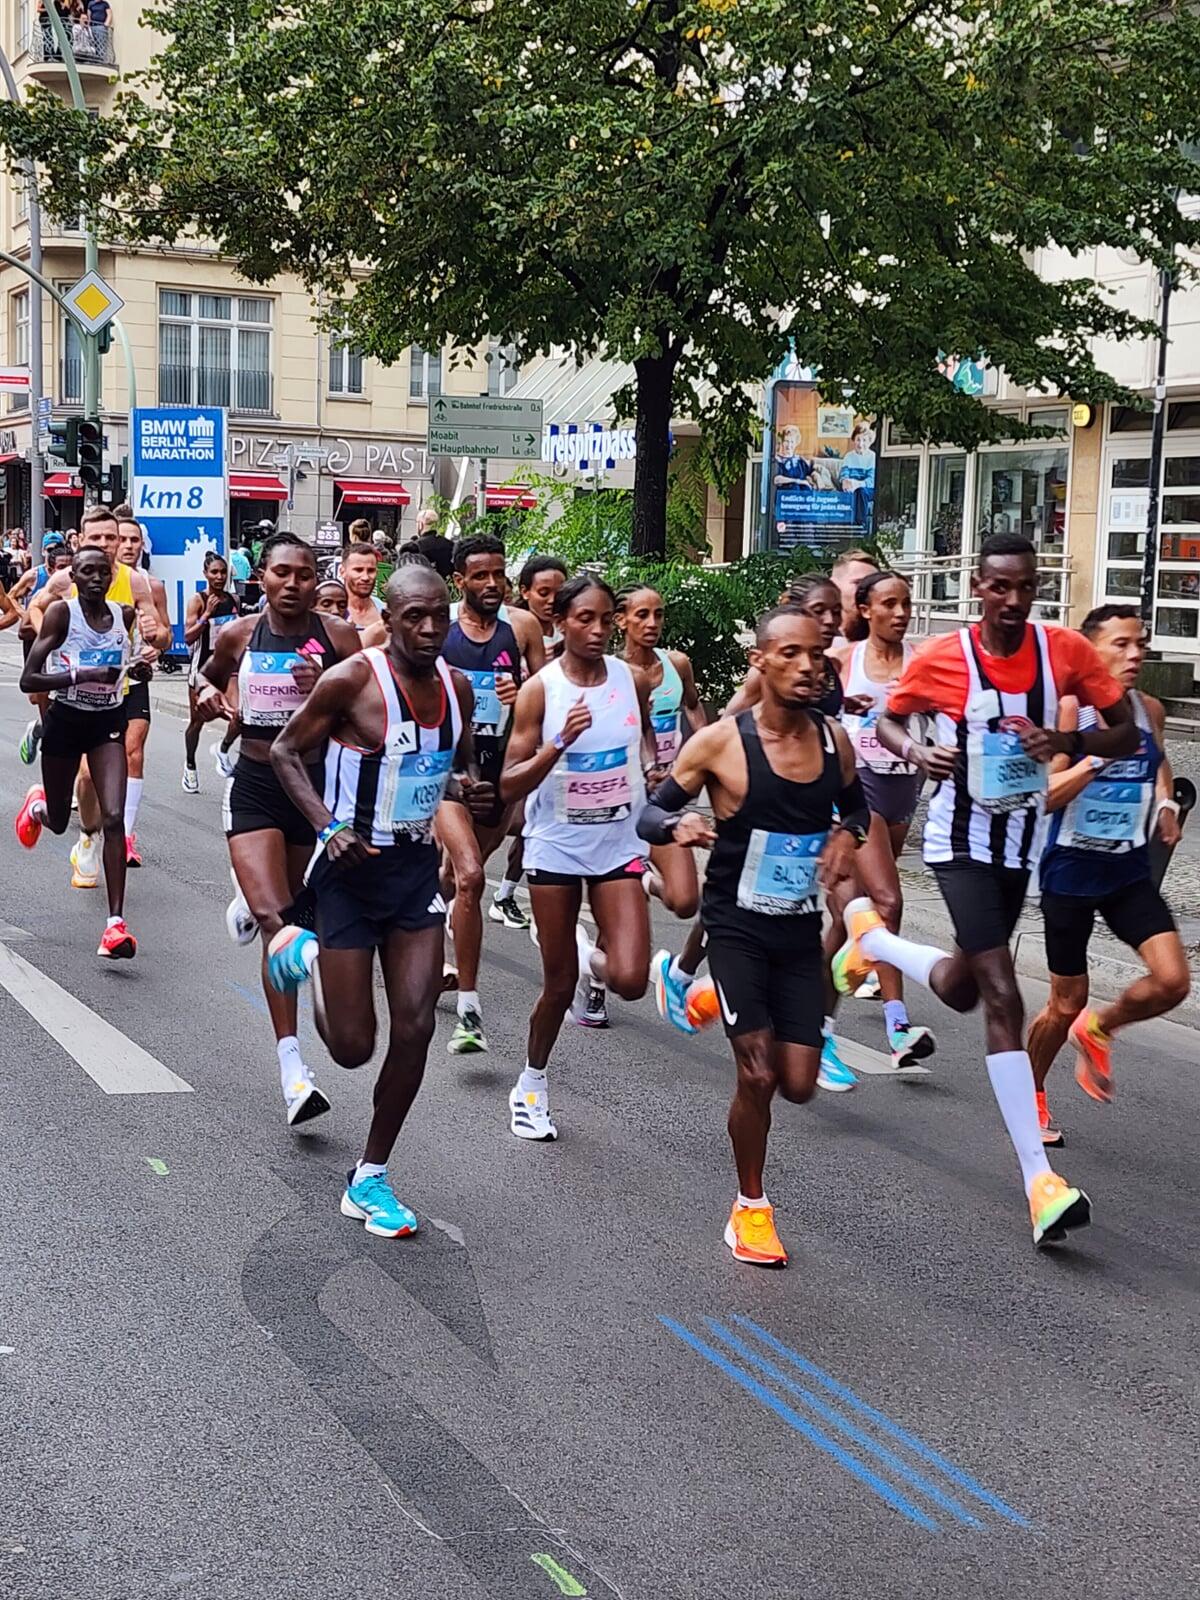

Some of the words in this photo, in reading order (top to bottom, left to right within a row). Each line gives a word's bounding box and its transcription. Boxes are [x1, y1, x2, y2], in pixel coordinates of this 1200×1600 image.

[141, 420, 186, 435] BMW
[141, 436, 187, 448] BERLIN
[431, 431, 459, 441] Moabit
[141, 448, 214, 460] MARATHON
[440, 444, 499, 455] Hauptbahnhof
[140, 484, 182, 509] km
[187, 486, 203, 509] 8
[568, 775, 630, 795] ASSEFA
